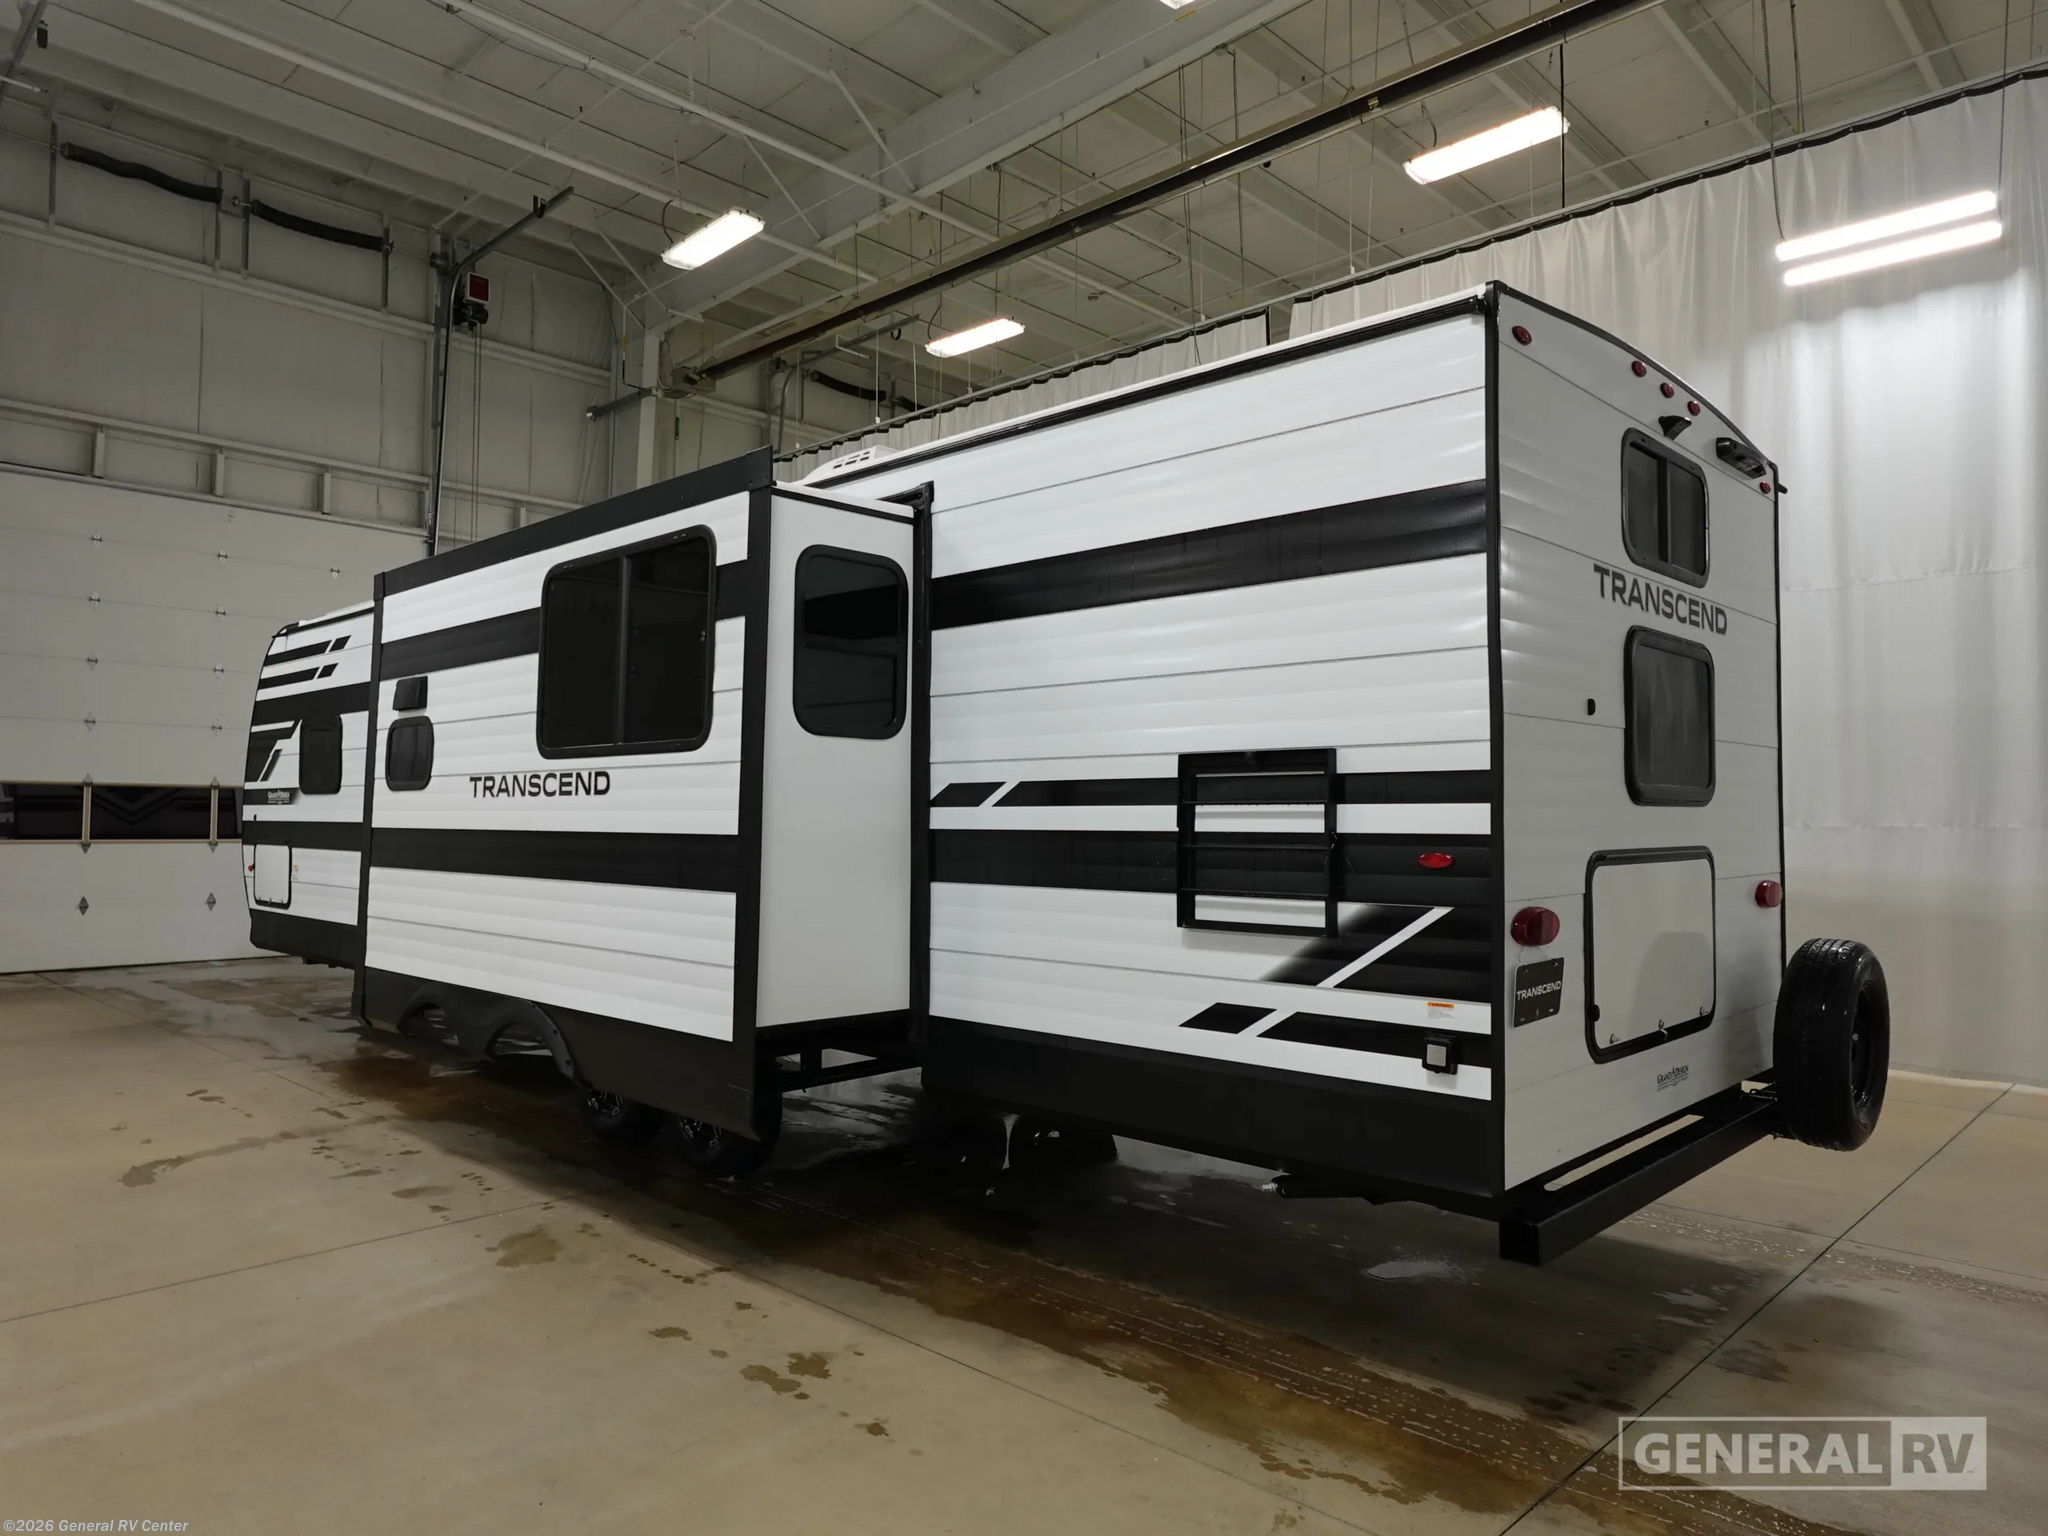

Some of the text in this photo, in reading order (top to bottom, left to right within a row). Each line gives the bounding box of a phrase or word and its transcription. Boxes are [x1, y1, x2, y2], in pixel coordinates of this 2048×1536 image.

[1593, 563, 1727, 635] TRANSCEND
[469, 771, 610, 798] TRANSCEND
[1516, 980, 1562, 1001] TRANSCEND
